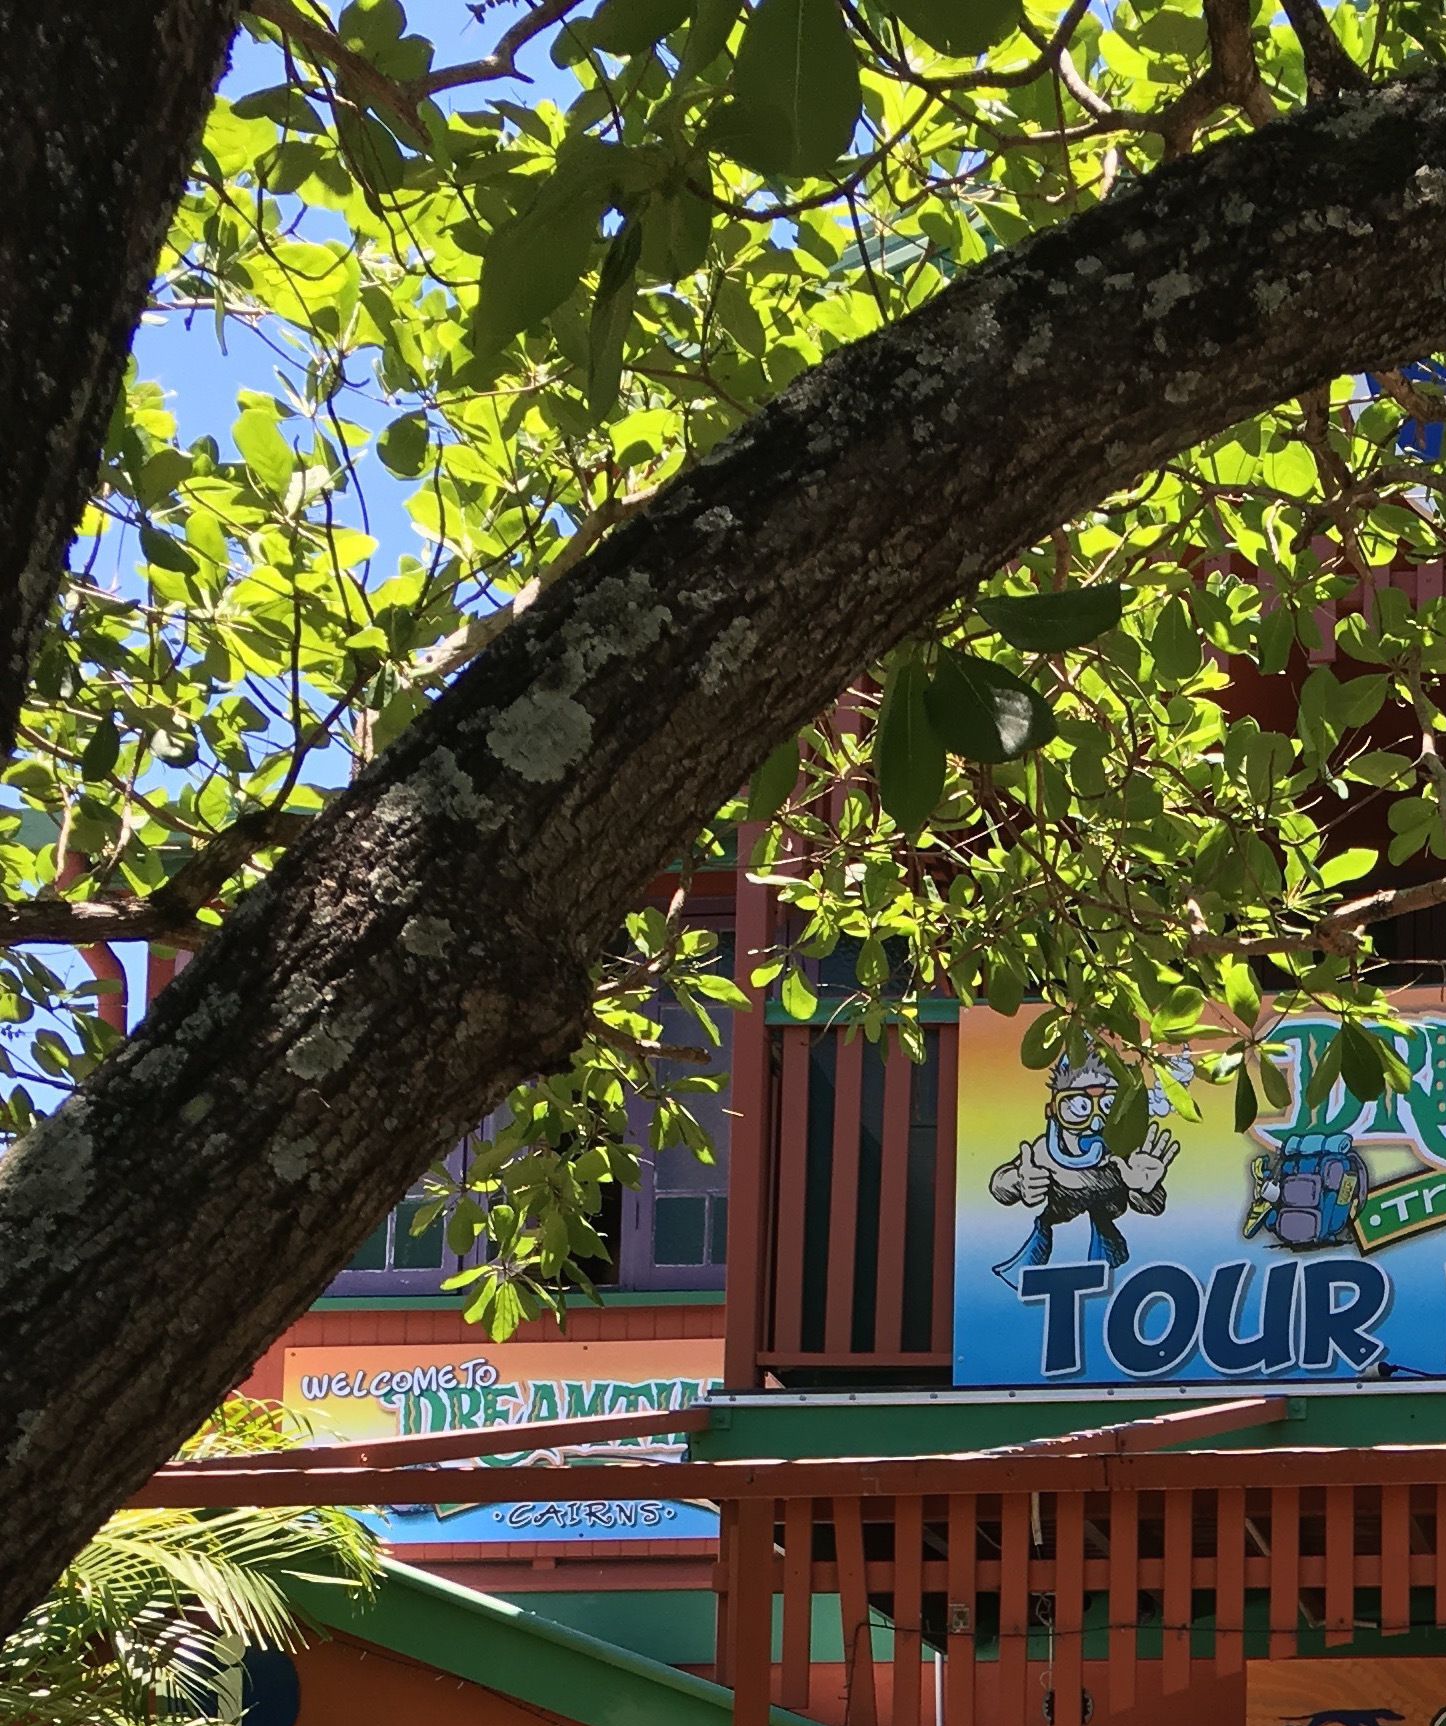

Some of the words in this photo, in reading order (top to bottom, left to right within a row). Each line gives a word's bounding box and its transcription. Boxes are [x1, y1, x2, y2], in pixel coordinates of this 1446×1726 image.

[1017, 1258, 1391, 1378] TOUR
[302, 1364, 456, 1400] WELCOME
[455, 1358, 498, 1388] TO
[507, 1501, 662, 1527] CAIRNS
